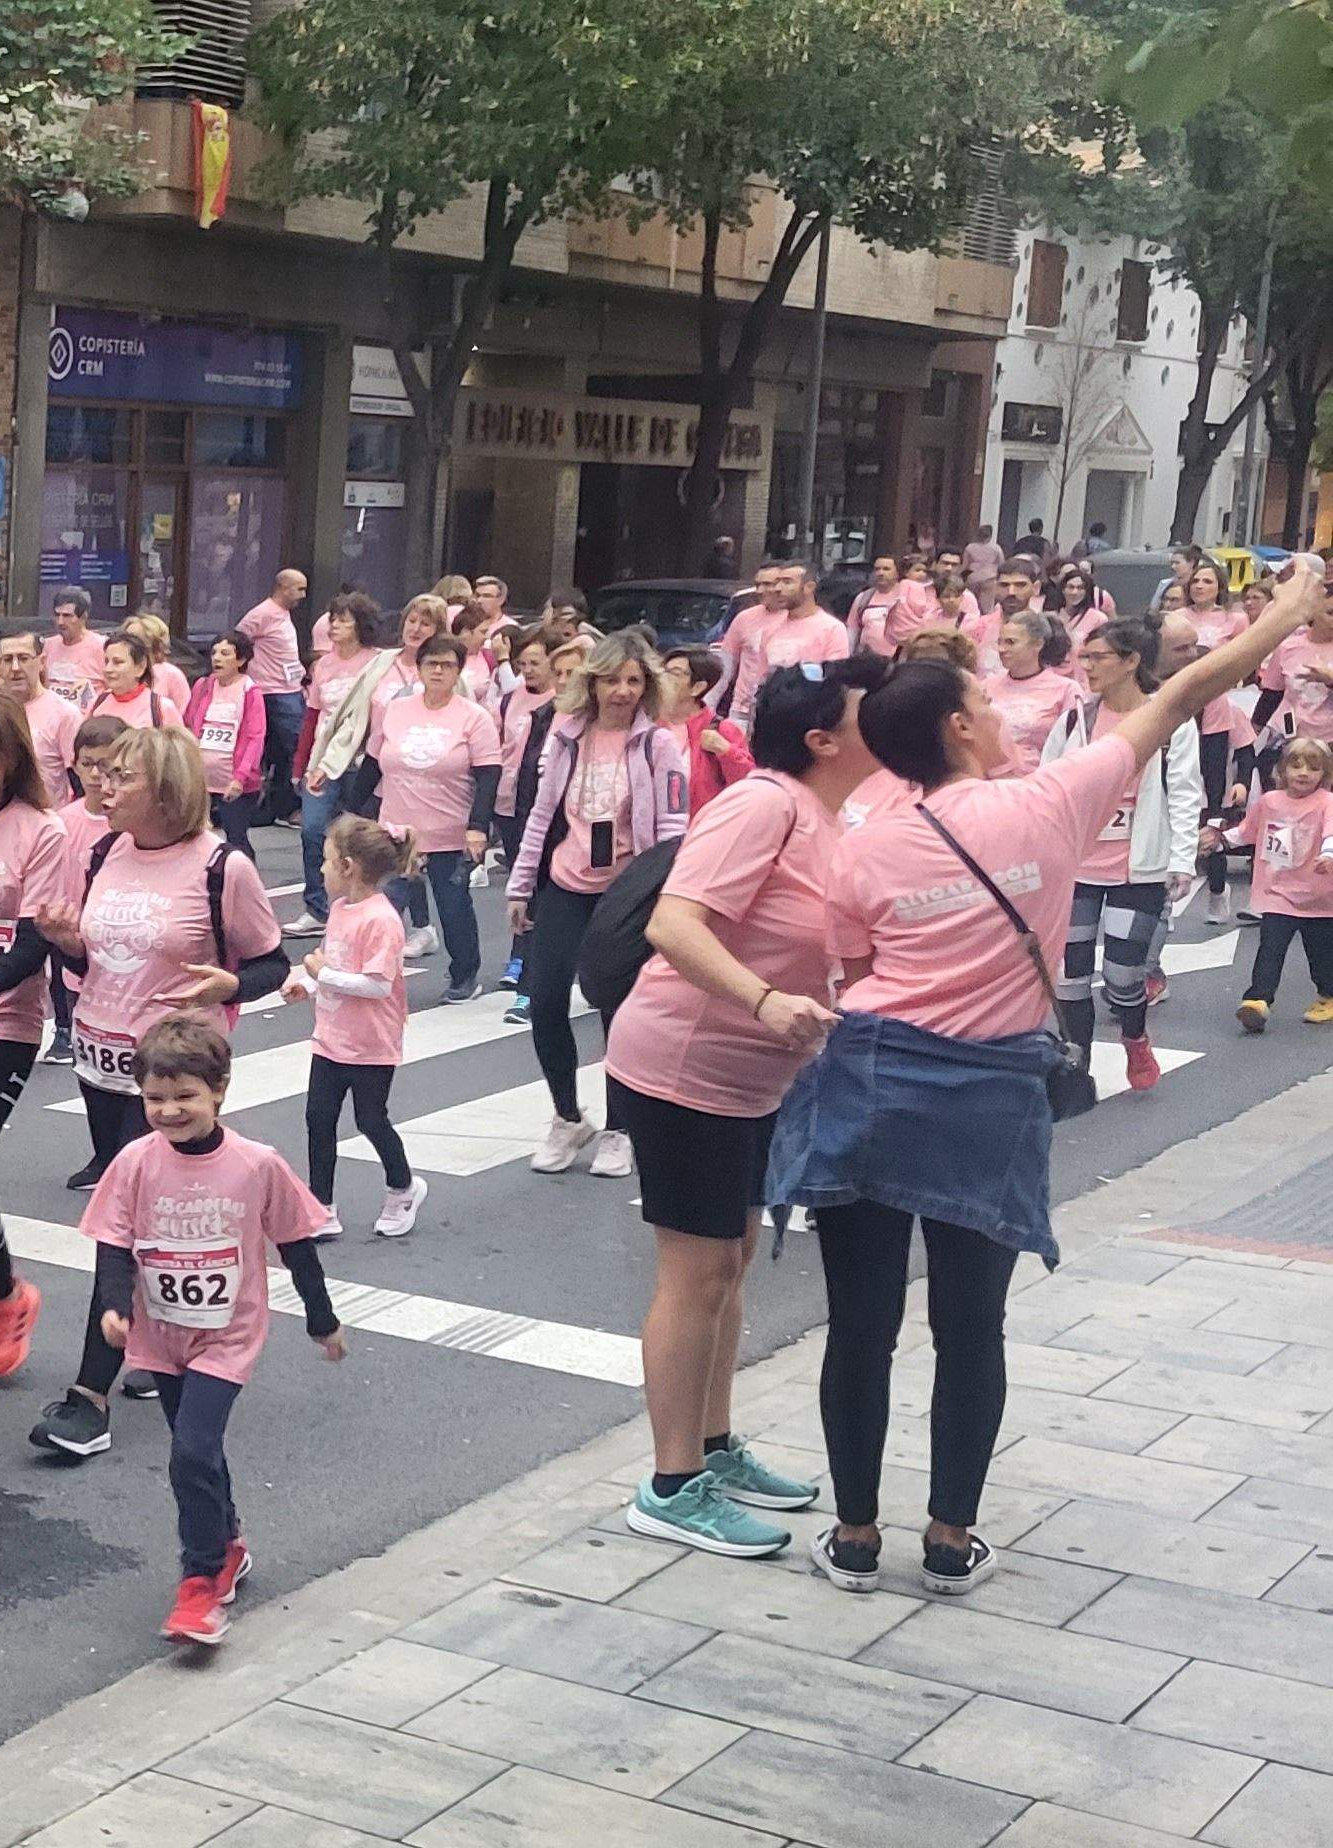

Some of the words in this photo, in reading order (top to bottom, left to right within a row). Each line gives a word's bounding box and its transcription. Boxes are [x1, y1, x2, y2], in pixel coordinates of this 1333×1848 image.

[78, 335, 147, 357] COPISTERÍA
[77, 358, 104, 377] CRM
[77, 1036, 134, 1076] 3186
[158, 1273, 230, 1306] 862
